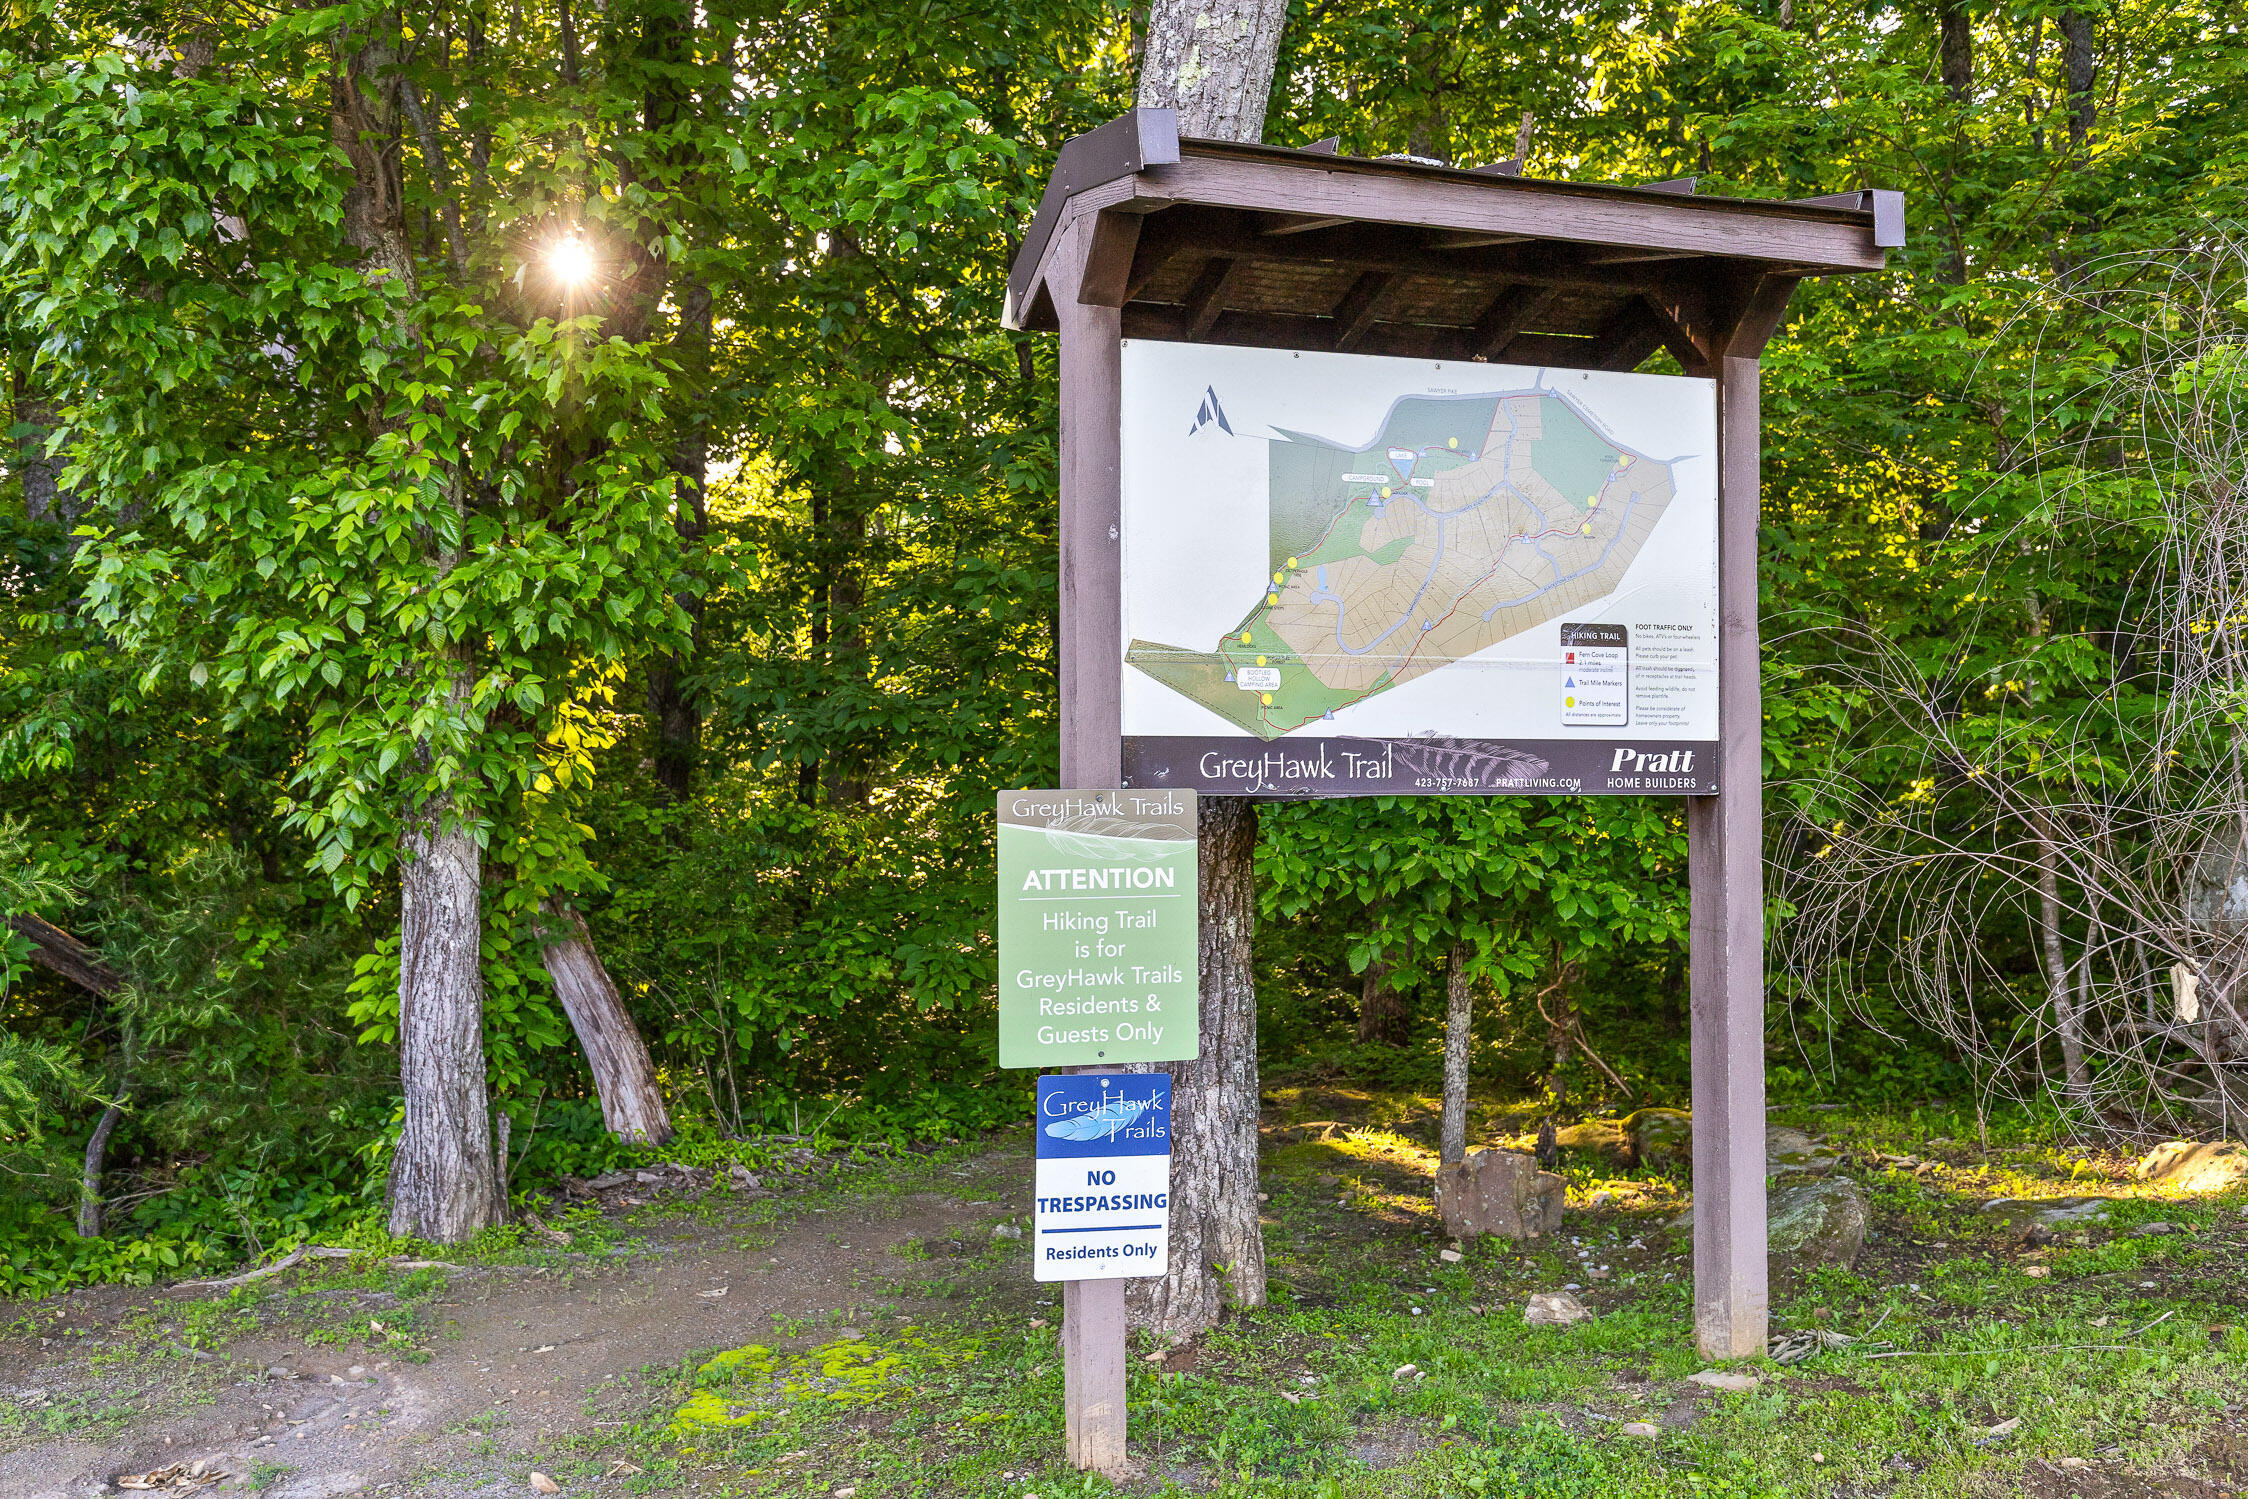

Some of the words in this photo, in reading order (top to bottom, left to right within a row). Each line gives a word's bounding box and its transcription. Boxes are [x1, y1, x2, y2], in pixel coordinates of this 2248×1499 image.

[1200, 742, 1336, 793] GreyHawk
[1340, 742, 1393, 779] Trail
[1609, 748, 1696, 772] Pratt
[1415, 778, 1480, 788] 423-757-7687
[1496, 778, 1581, 788] PRATTLIVING.COM
[1607, 778, 1641, 788] HOME
[1645, 778, 1697, 788] BUILDERS
[1012, 792, 1124, 827] GreyHawk
[1130, 792, 1184, 816] Trails
[1022, 867, 1174, 891] ATTENTION
[1043, 912, 1108, 934] Hiking
[1115, 909, 1157, 929] Trail
[1074, 941, 1090, 958] is
[1096, 938, 1126, 957] for
[1016, 968, 1124, 993] GreyHawk
[1131, 964, 1183, 984] Trails
[1039, 996, 1139, 1016] Residents
[1146, 994, 1162, 1012] &
[1037, 1026, 1109, 1045] Guests
[1116, 1021, 1164, 1045] Only
[1043, 1088, 1164, 1120] GreyHawk
[1102, 1116, 1166, 1143] Trails
[1088, 1170, 1116, 1186] NO
[1038, 1193, 1167, 1214] TRESPASSING
[1046, 1246, 1119, 1260] Residents
[1122, 1242, 1158, 1259] Only
